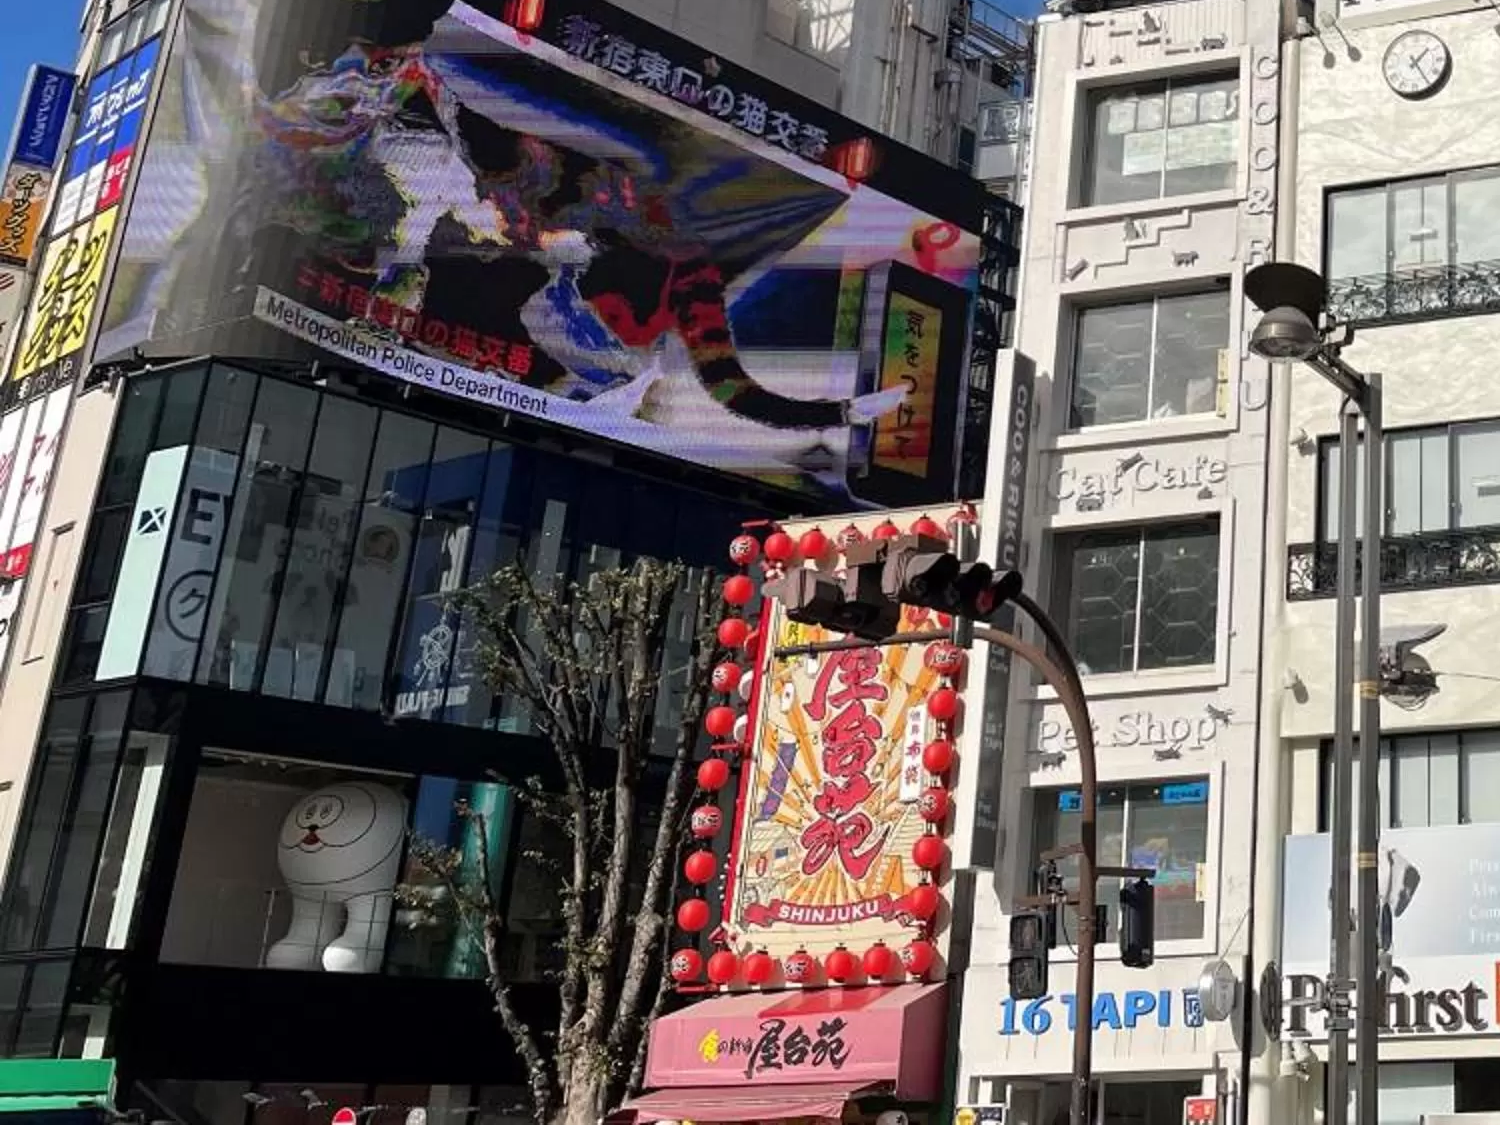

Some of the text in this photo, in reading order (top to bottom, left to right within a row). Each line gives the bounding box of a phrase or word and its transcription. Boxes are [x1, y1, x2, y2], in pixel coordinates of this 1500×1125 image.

[558, 13, 830, 162] 新宿東口の猫交番
[266, 296, 549, 415] Metropolitan Police Department
[1012, 383, 1028, 452] COO
[1002, 481, 1021, 567] RIKU
[777, 897, 882, 923] SHINJUKU
[998, 989, 1173, 1036] 16 TAPI
